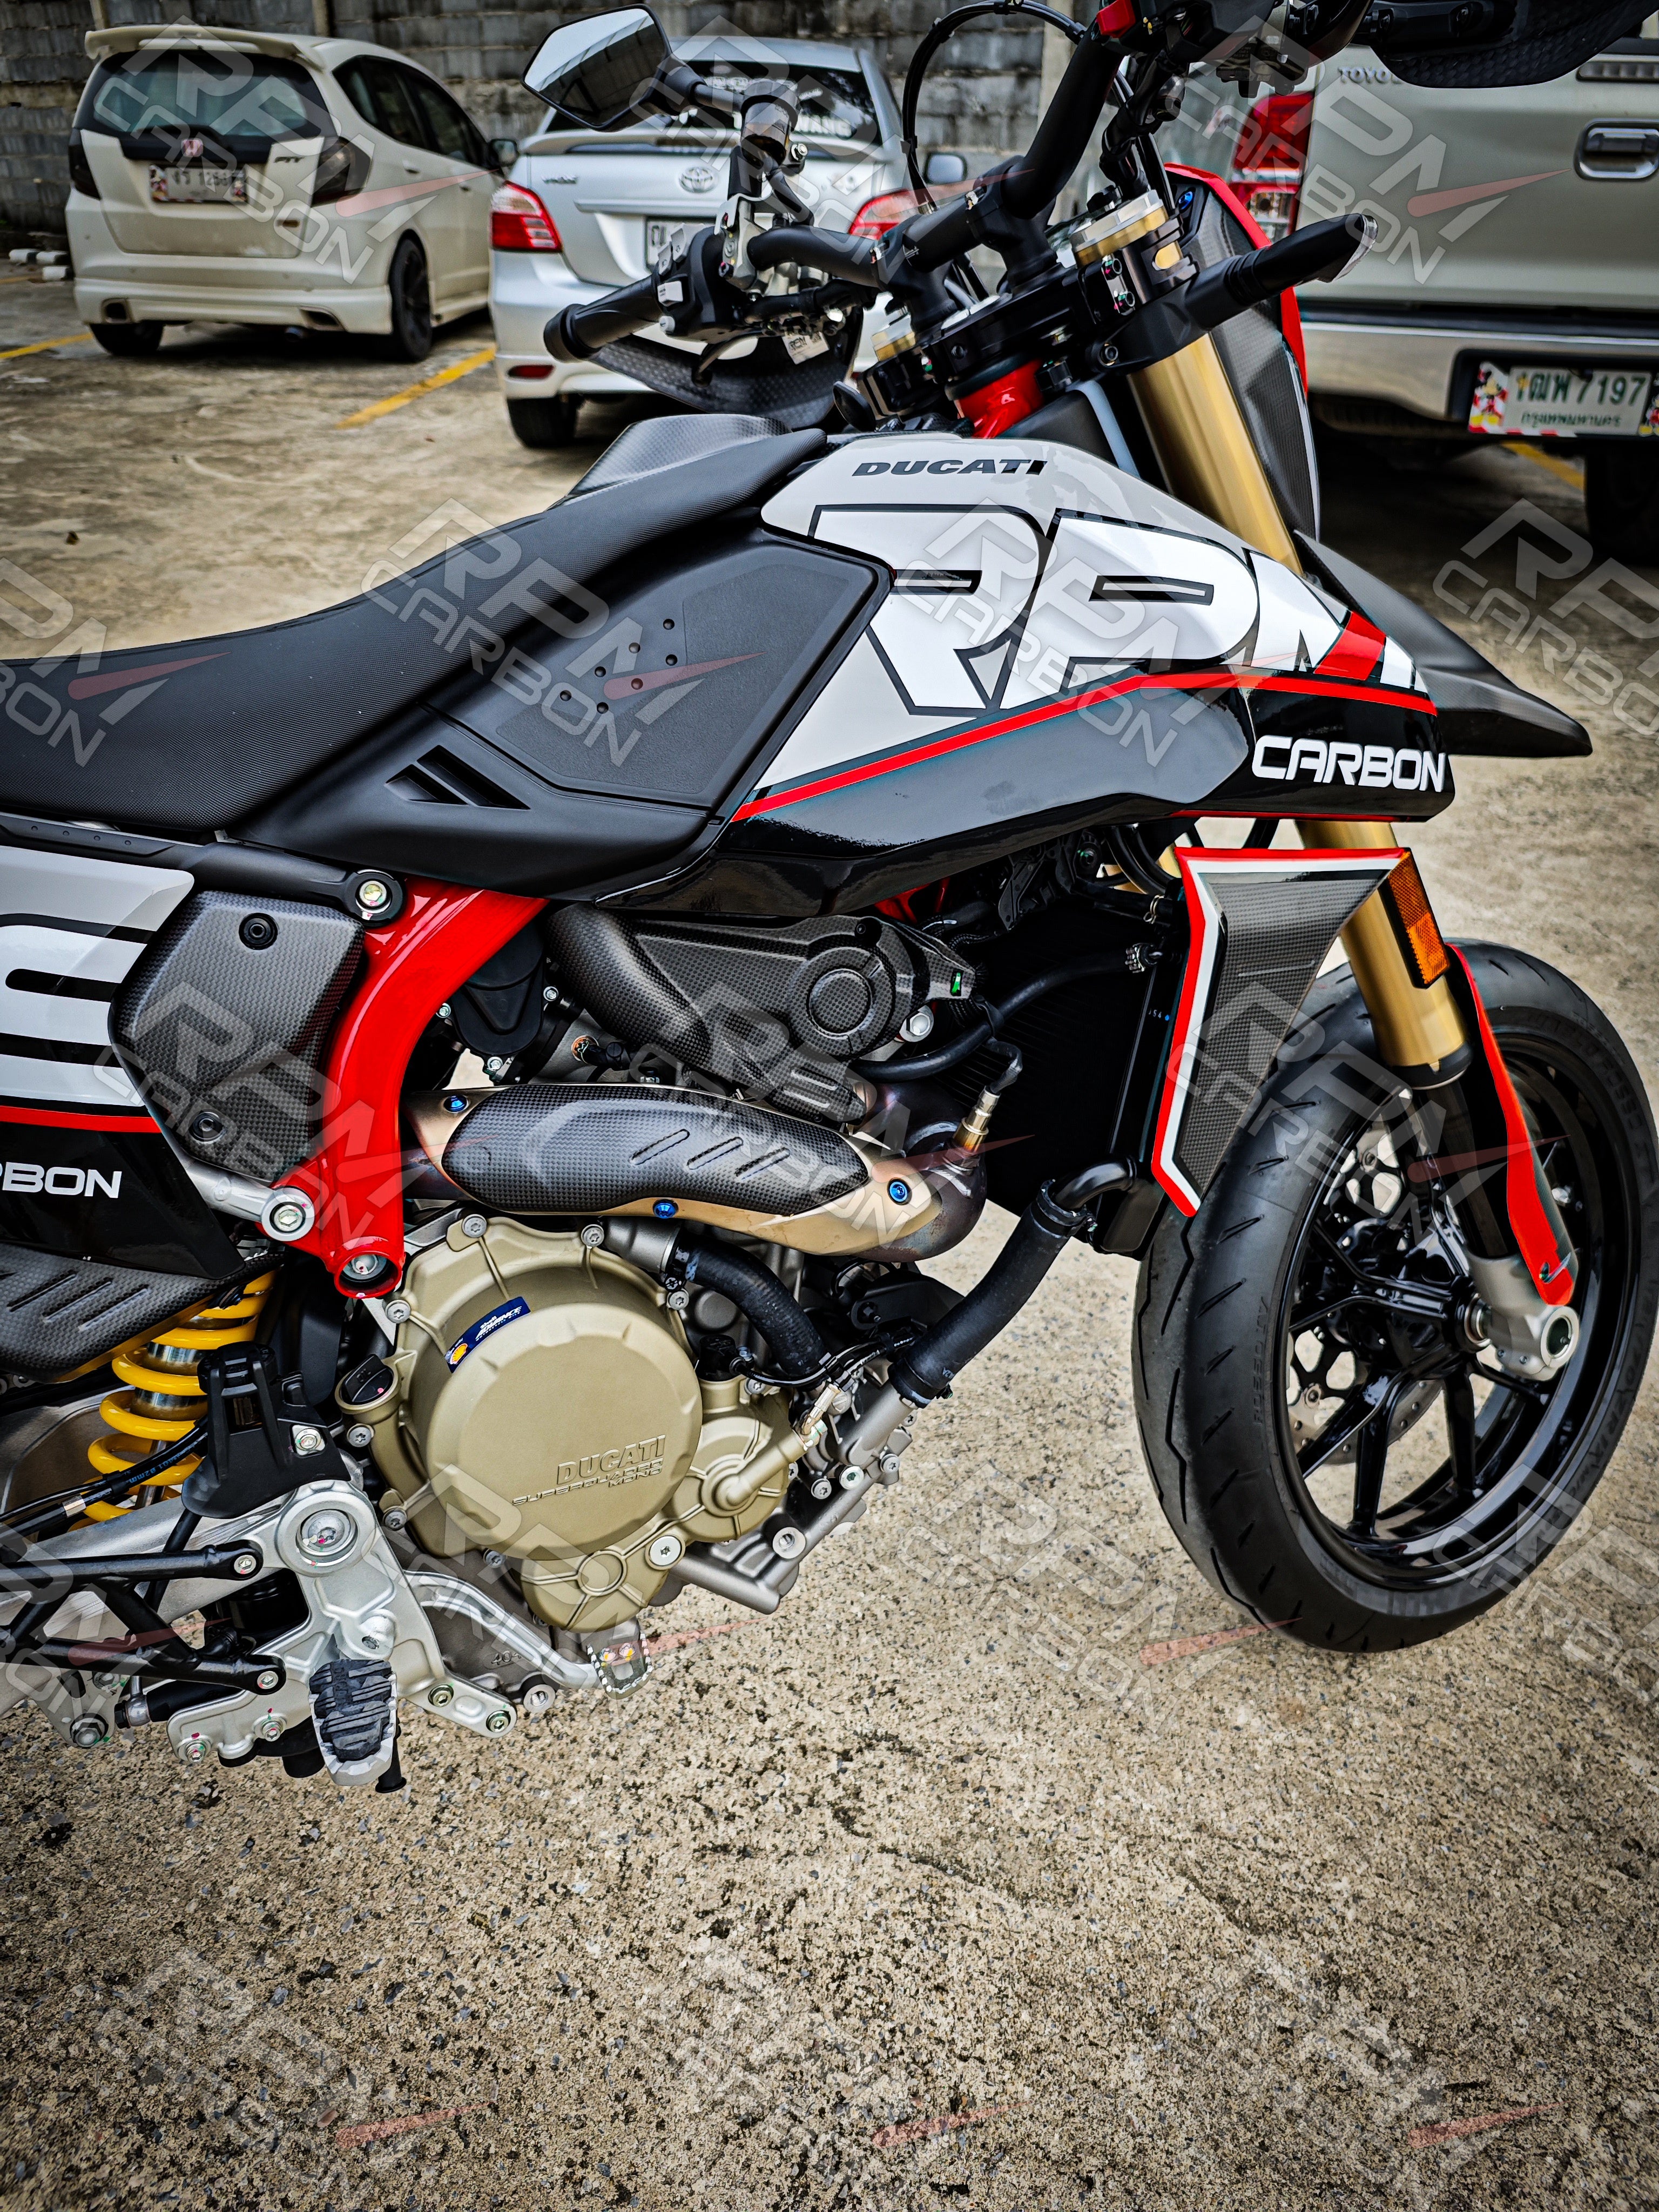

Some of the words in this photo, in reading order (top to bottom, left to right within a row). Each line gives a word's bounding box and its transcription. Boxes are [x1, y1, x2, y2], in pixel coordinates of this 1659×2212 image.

[1337, 66, 1402, 84] TOYO
[1576, 375, 1646, 406] 7197
[852, 459, 1048, 477] DUCATI
[1251, 735, 1446, 793] CARBON
[0, 1161, 122, 1199] BON
[556, 1434, 666, 1485] DUCATI
[608, 1465, 663, 1488] MONO
[512, 1458, 664, 1506] SUPERQUADRO
